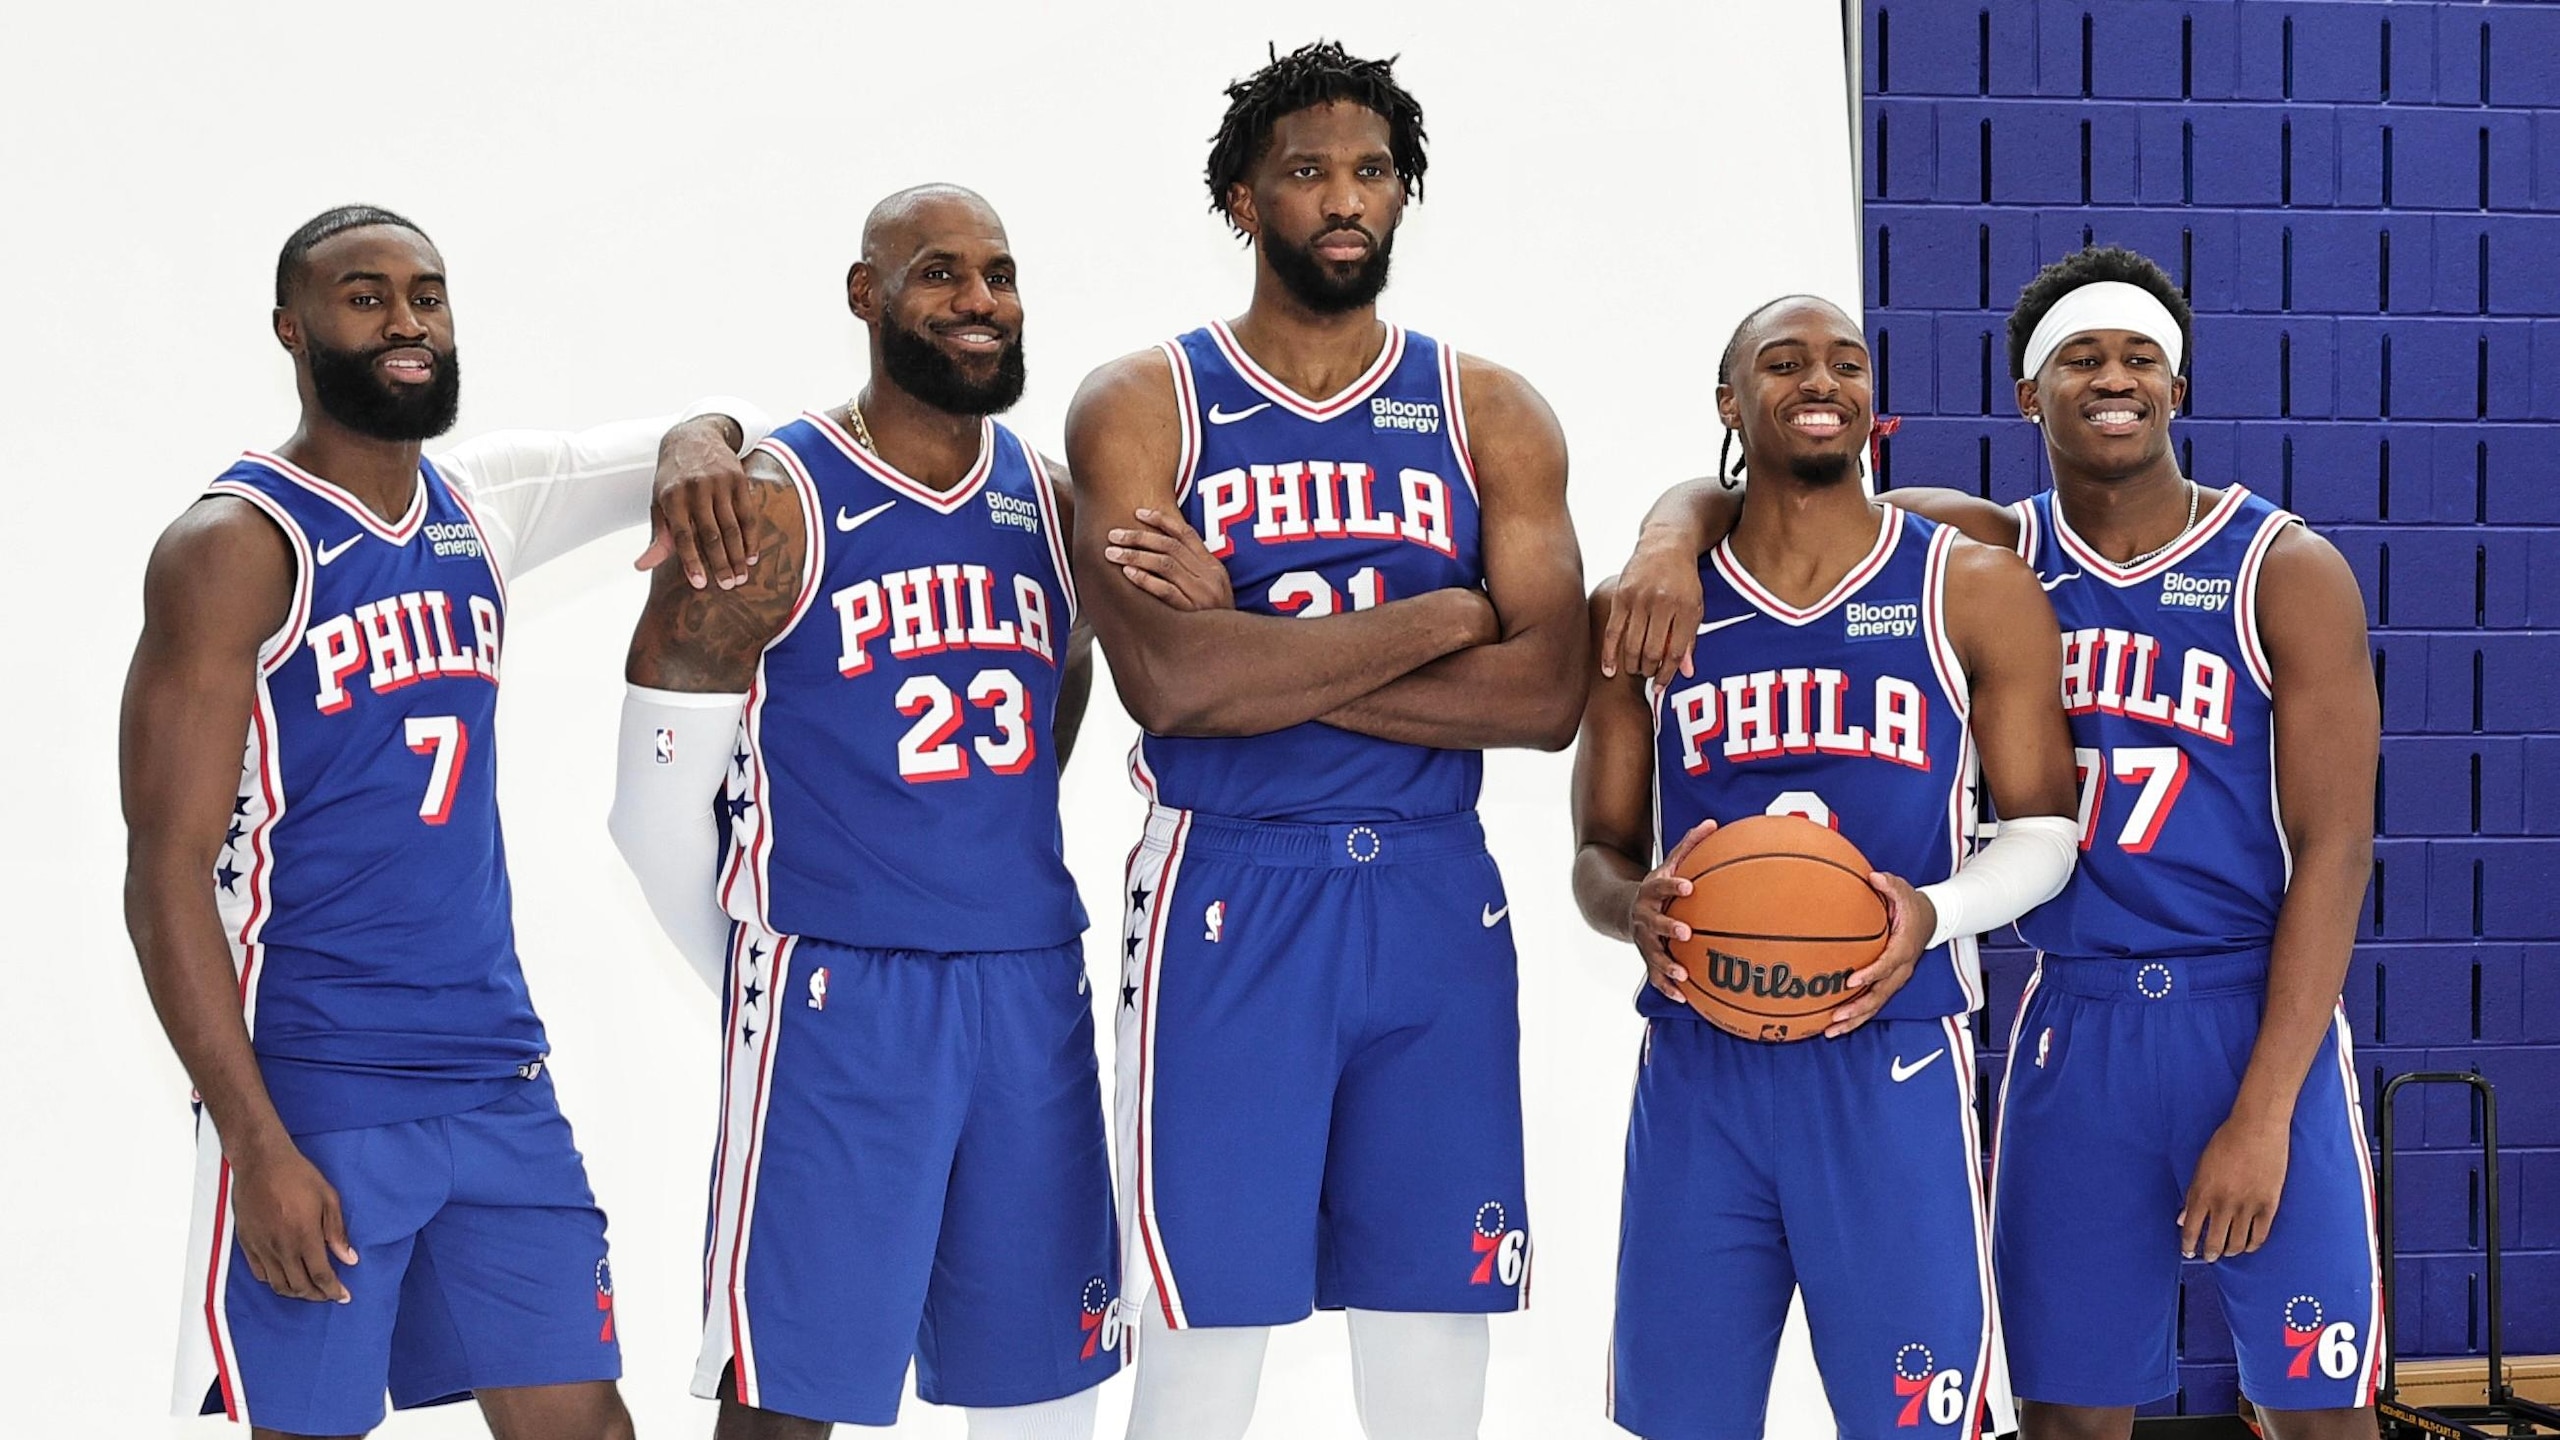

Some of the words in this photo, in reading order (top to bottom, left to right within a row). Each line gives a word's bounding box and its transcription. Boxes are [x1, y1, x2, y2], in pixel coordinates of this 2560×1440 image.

[1370, 398, 1439, 418] Bloom
[1373, 414, 1440, 433] energy
[423, 522, 475, 541] Bloom
[985, 491, 1037, 518] Bloom
[991, 509, 1038, 534] energy
[1197, 460, 1457, 559] PHILA
[434, 539, 482, 558] energy
[1846, 602, 1917, 622] Bloom
[2160, 591, 2229, 611] energy
[2163, 572, 2232, 595] Bloom
[831, 563, 1056, 679] PHILA
[1846, 618, 1917, 637] energy
[306, 590, 500, 715] PHILA
[2060, 627, 2236, 746] HILA
[894, 668, 1036, 784] 23
[1670, 667, 1931, 777] PHILA
[404, 715, 469, 826] 7
[2074, 747, 2190, 854] 77
[1706, 948, 1856, 998] Wilson
[1470, 1228, 1525, 1287] 76
[1080, 1297, 1120, 1361] 76
[2285, 1321, 2358, 1379] 76
[1895, 1368, 1964, 1428] 76
